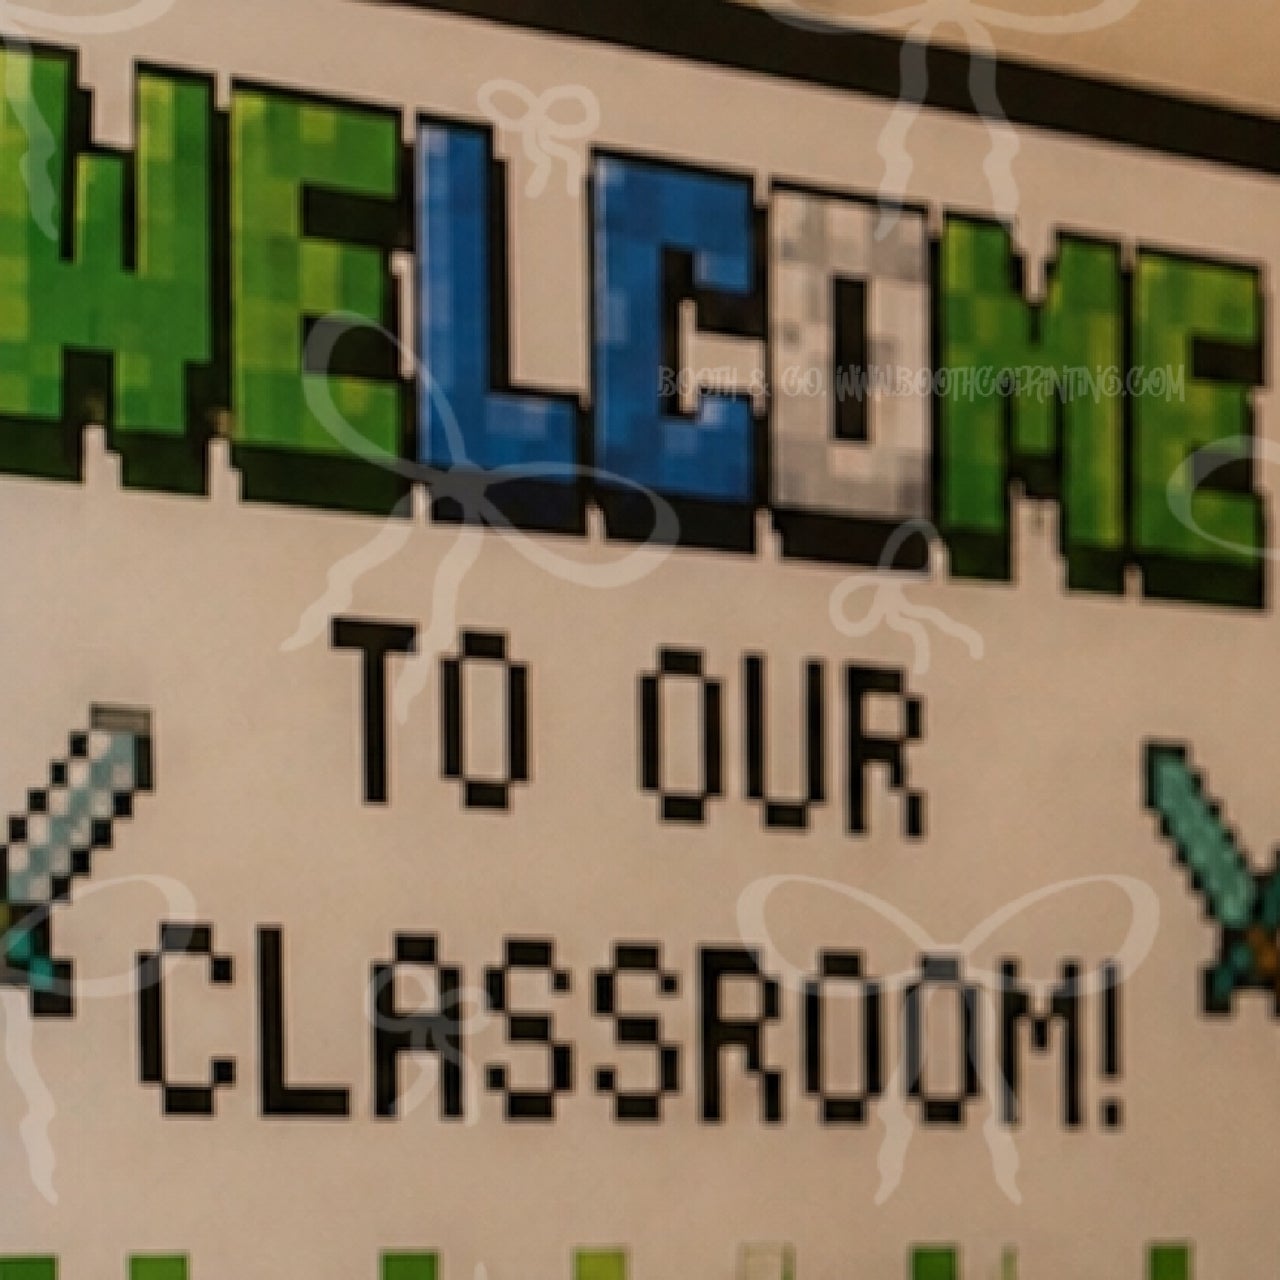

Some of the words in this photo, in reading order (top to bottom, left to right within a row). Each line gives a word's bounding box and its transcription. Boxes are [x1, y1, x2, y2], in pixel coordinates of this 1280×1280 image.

[0, 36, 1267, 610] WELCOME
[331, 618, 529, 811] TO
[639, 649, 923, 838] OUR
[137, 923, 1122, 1127] CLASSROOM!
